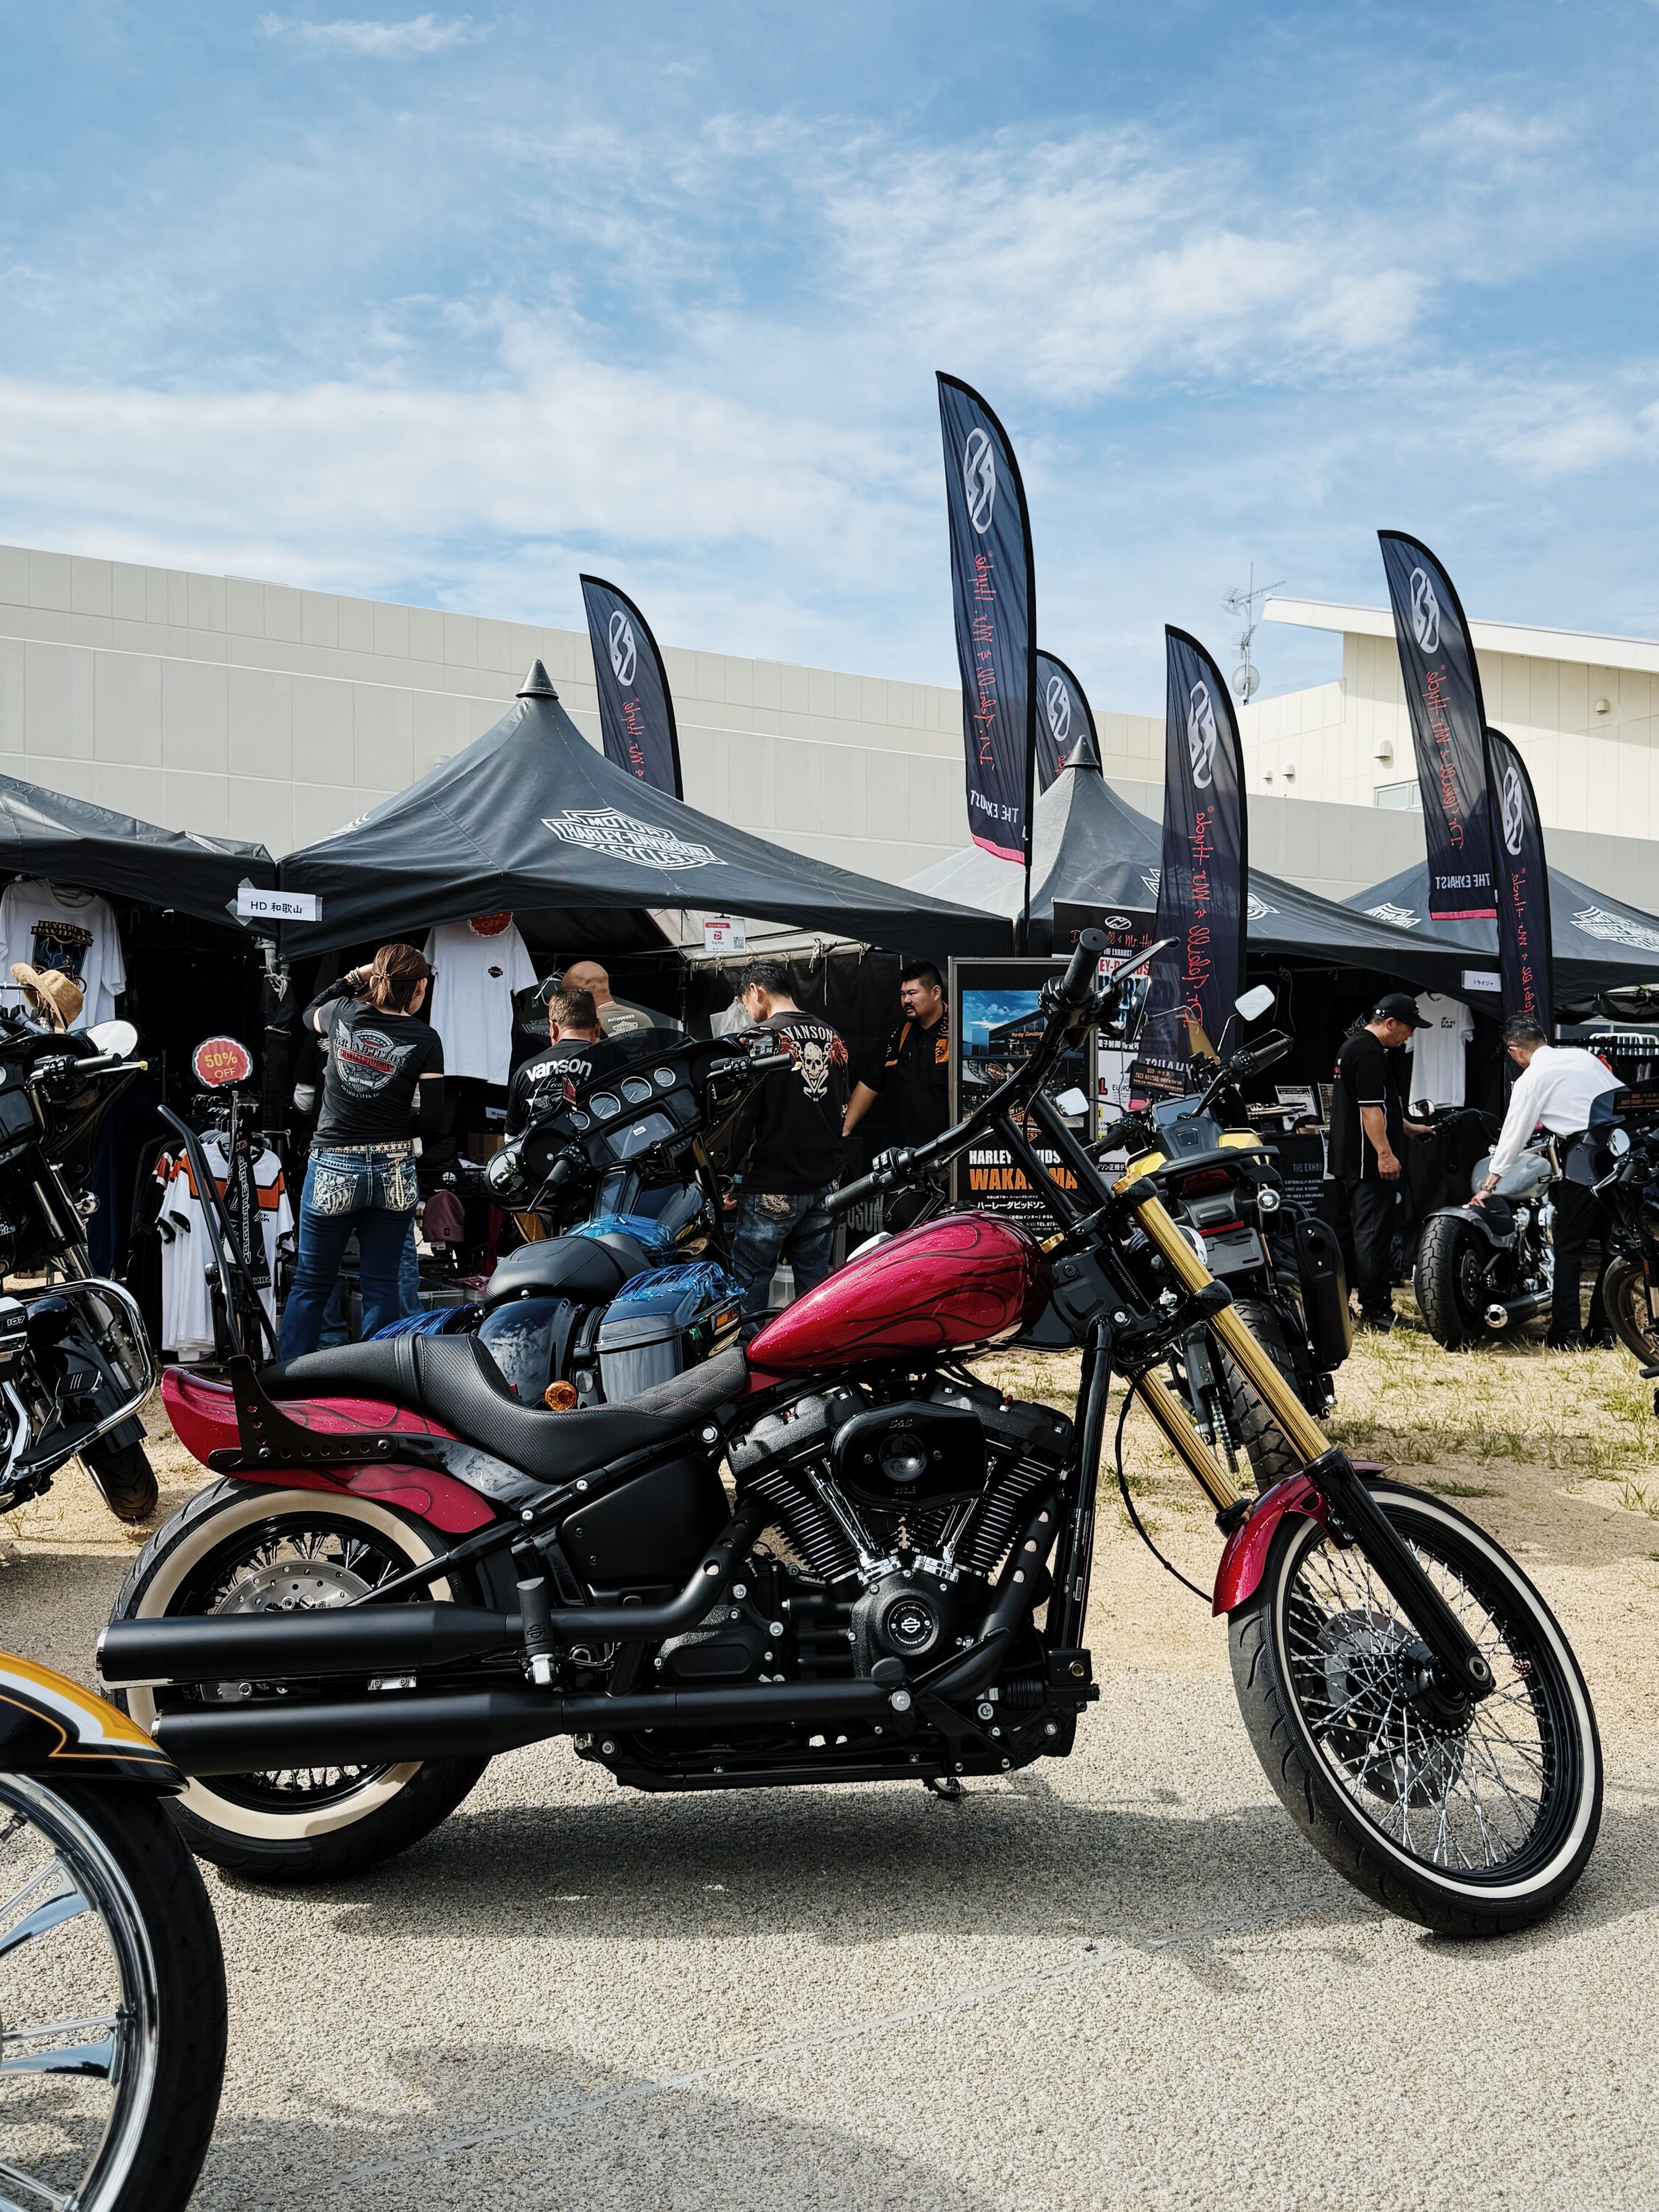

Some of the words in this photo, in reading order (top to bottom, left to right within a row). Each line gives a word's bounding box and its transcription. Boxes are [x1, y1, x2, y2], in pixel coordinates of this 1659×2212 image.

[589, 816, 661, 838] MOTOR
[563, 823, 709, 858] HARLEY-DAVIDSON
[608, 844, 684, 866] CYCLES
[251, 901, 267, 910] HD
[271, 902, 302, 914] 和歌山
[483, 919, 501, 928] OFF
[1112, 948, 1133, 957] EXHAUST
[782, 1025, 833, 1043] VANSON
[204, 1051, 238, 1068] 50%
[215, 1068, 236, 1078] OFF
[526, 1058, 592, 1082] vanson
[970, 1168, 1078, 1190] WAKAMA
[977, 1200, 1046, 1209] ハーレーダビッドソン
[7, 1315, 25, 1326] 107
